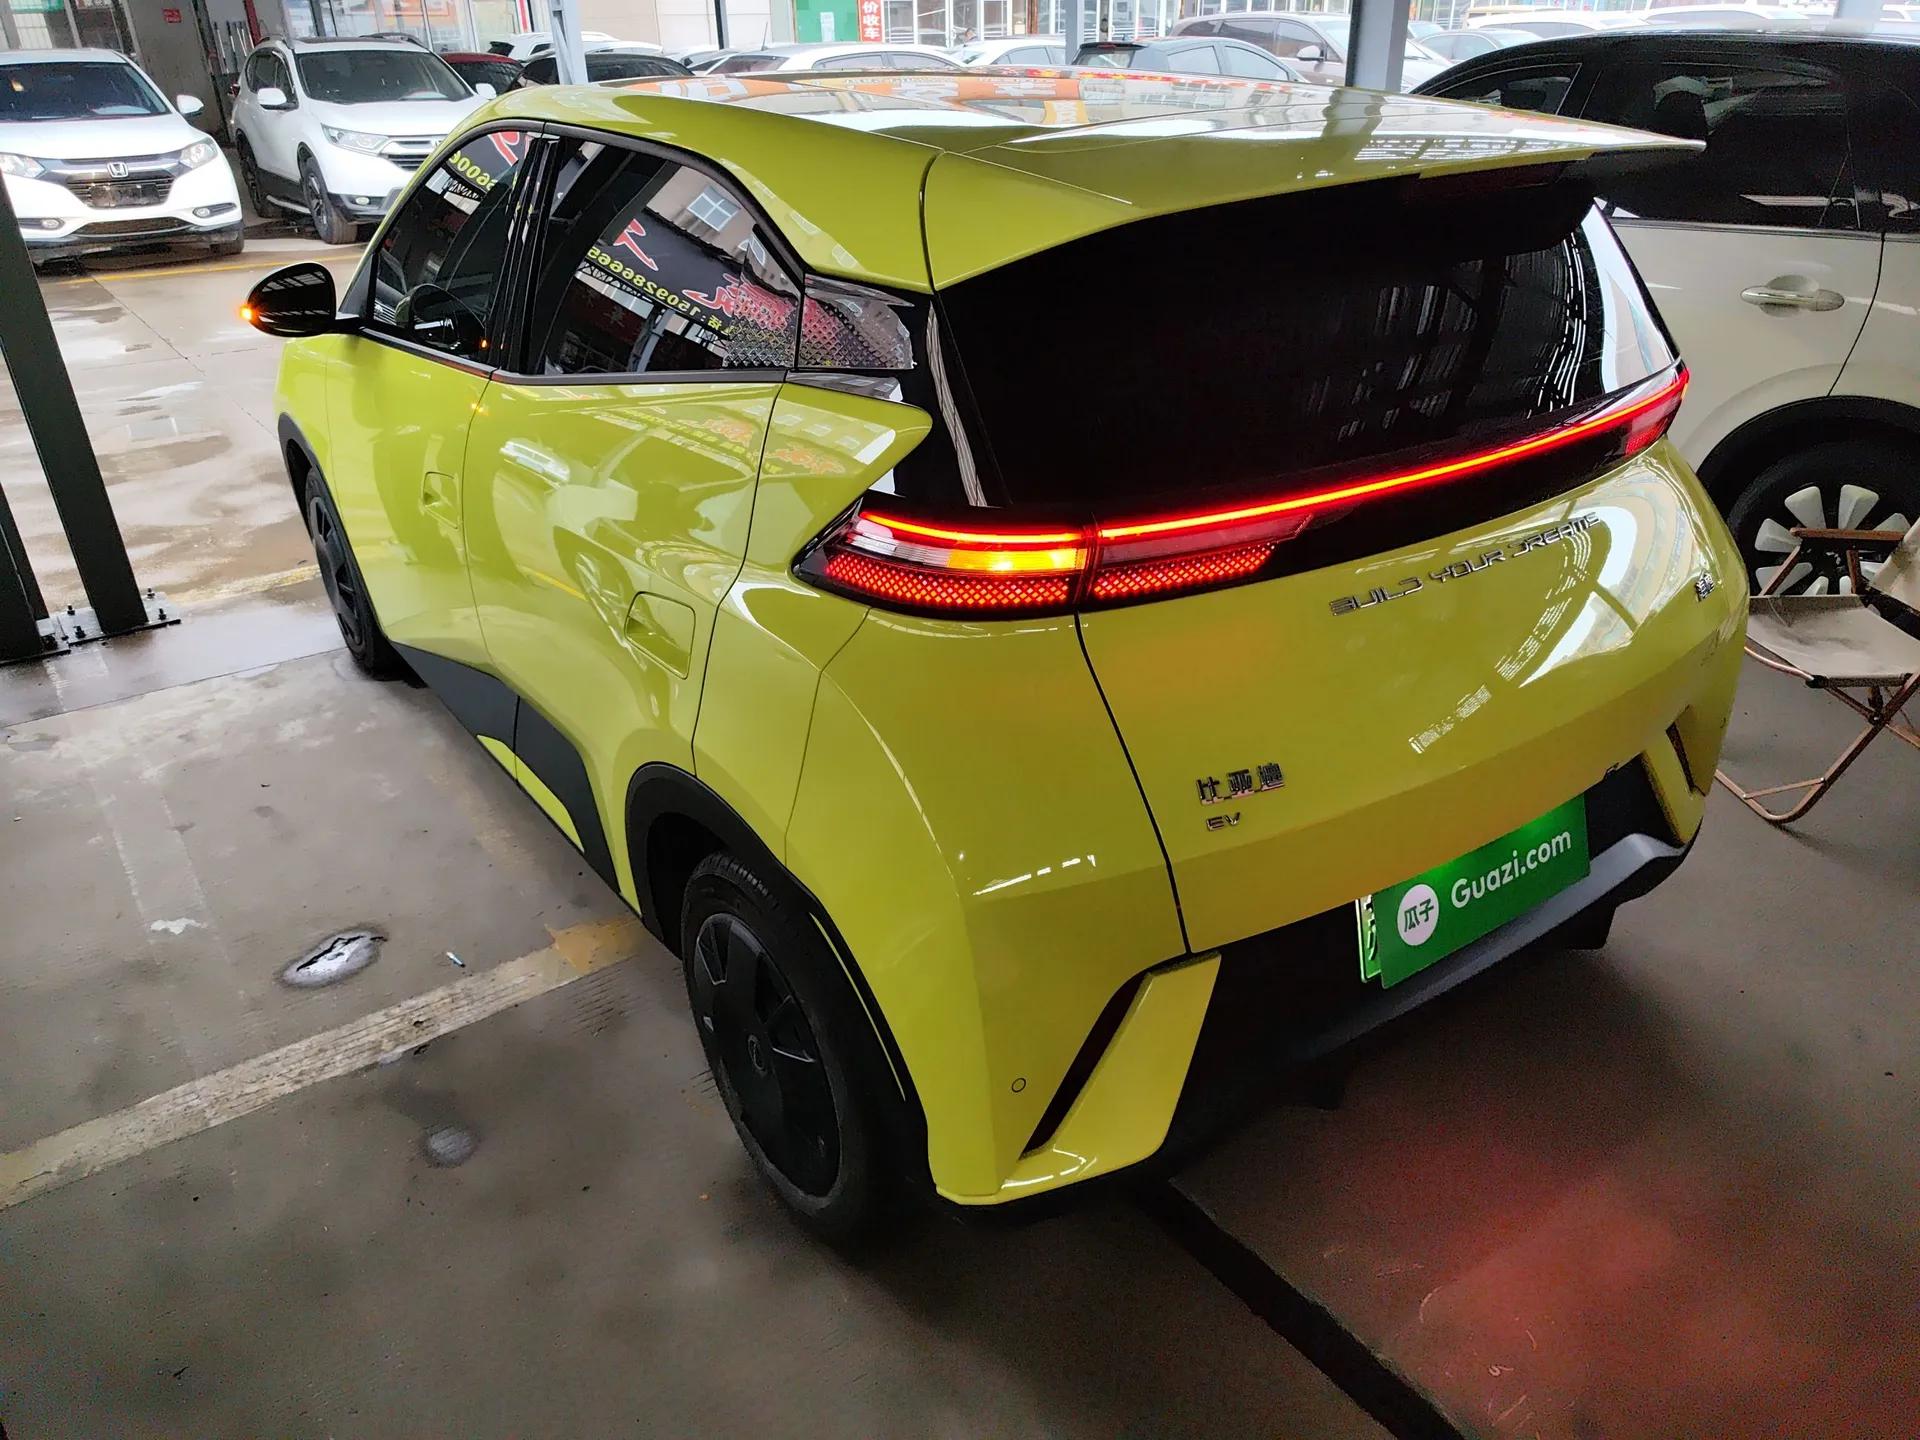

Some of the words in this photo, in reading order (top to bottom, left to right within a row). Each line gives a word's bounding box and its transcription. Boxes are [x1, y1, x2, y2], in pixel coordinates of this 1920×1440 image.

[1329, 576, 1423, 616] BUILD
[1429, 549, 1506, 583] YOUR
[1508, 511, 1600, 558] DREAMS
[1196, 762, 1285, 805] 比亚迪
[1206, 811, 1241, 832] EV
[1451, 831, 1571, 908] Guazi.com
[1403, 898, 1435, 933] 瓜子
